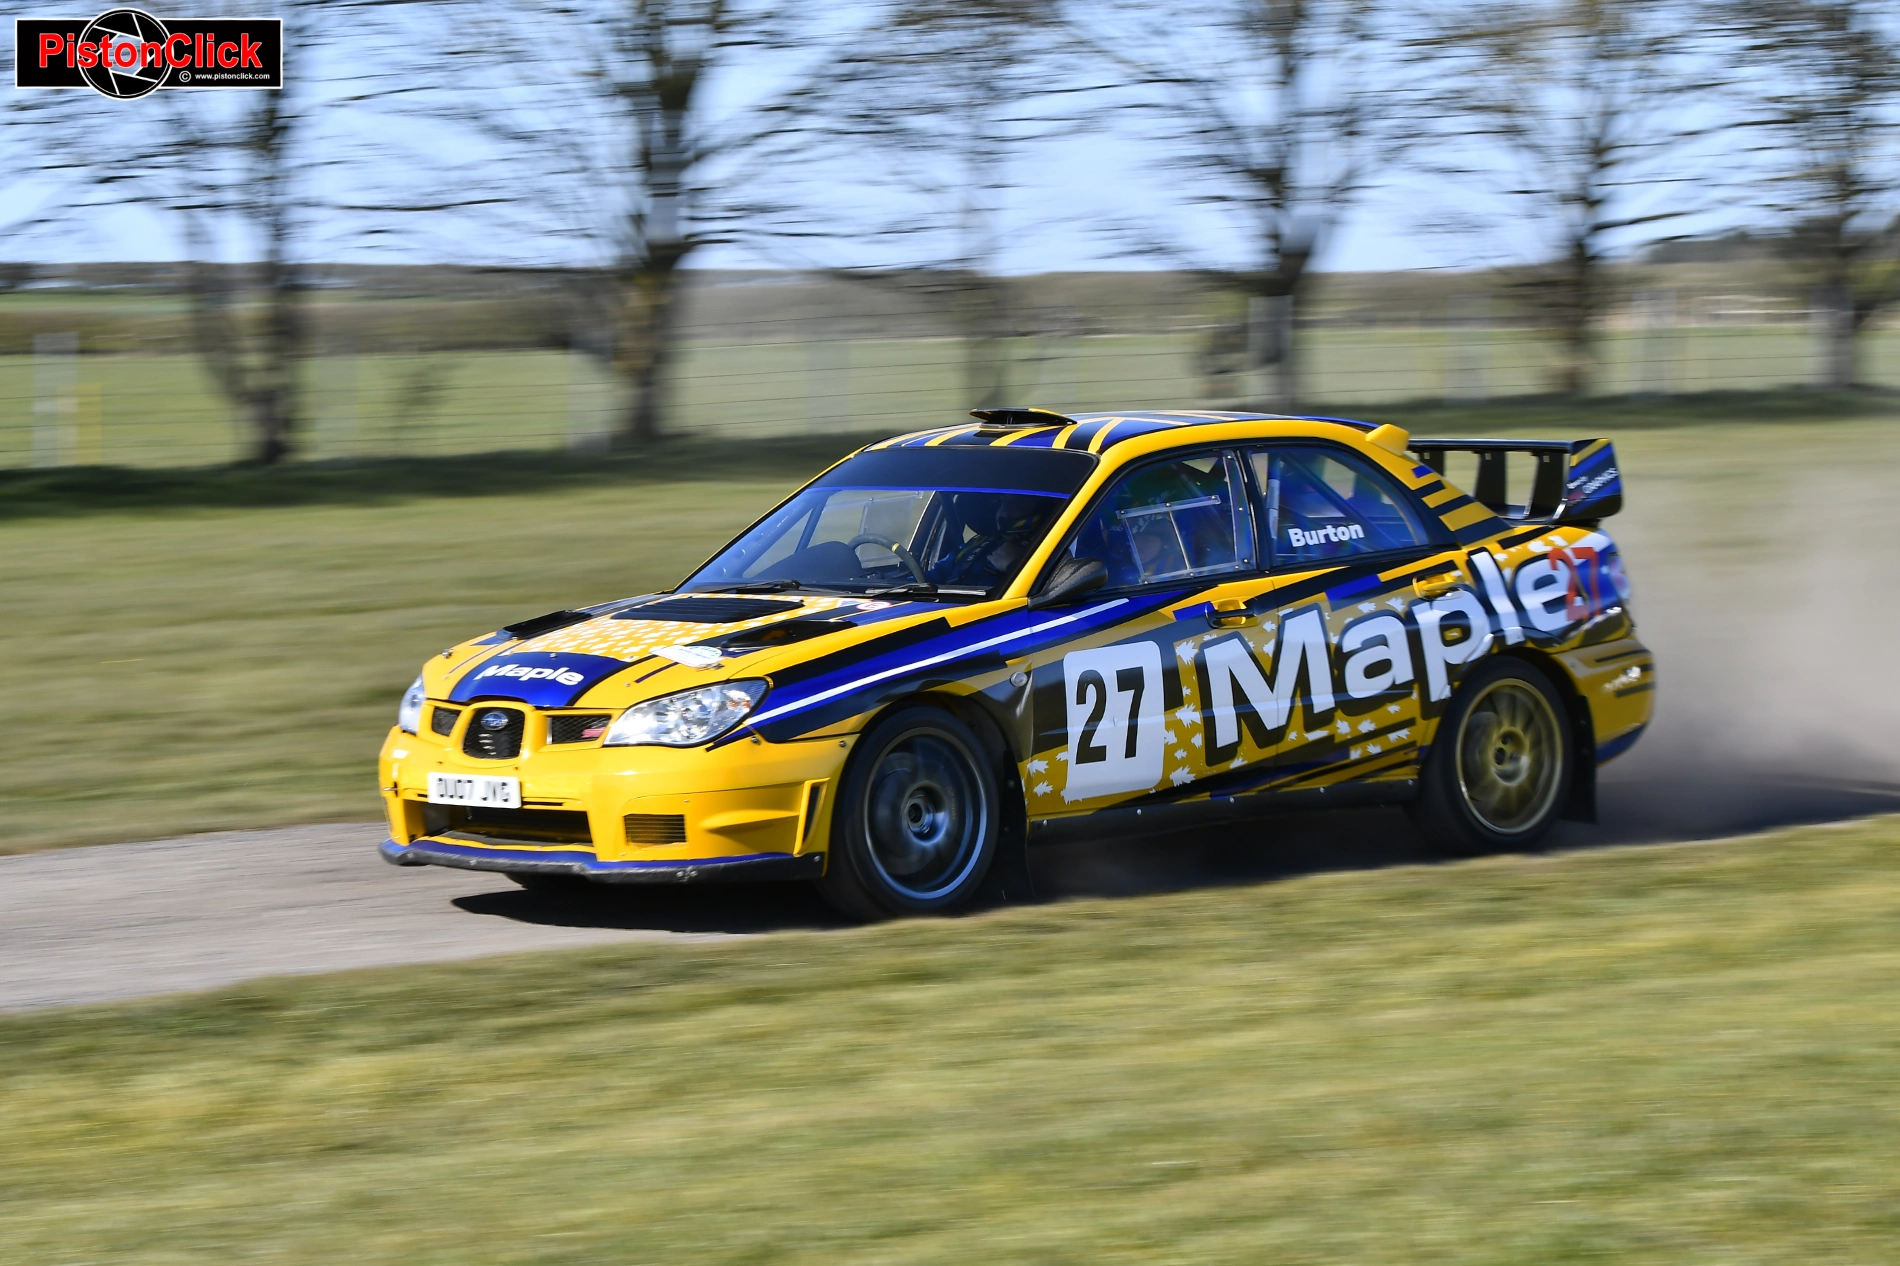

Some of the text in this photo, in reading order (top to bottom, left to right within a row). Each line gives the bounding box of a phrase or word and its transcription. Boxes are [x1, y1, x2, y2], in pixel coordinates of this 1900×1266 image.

[1288, 524, 1365, 547] Burton
[1547, 547, 1602, 621] 27
[473, 664, 584, 686] Maple
[1203, 551, 1571, 748] Maple
[1075, 666, 1145, 765] 27
